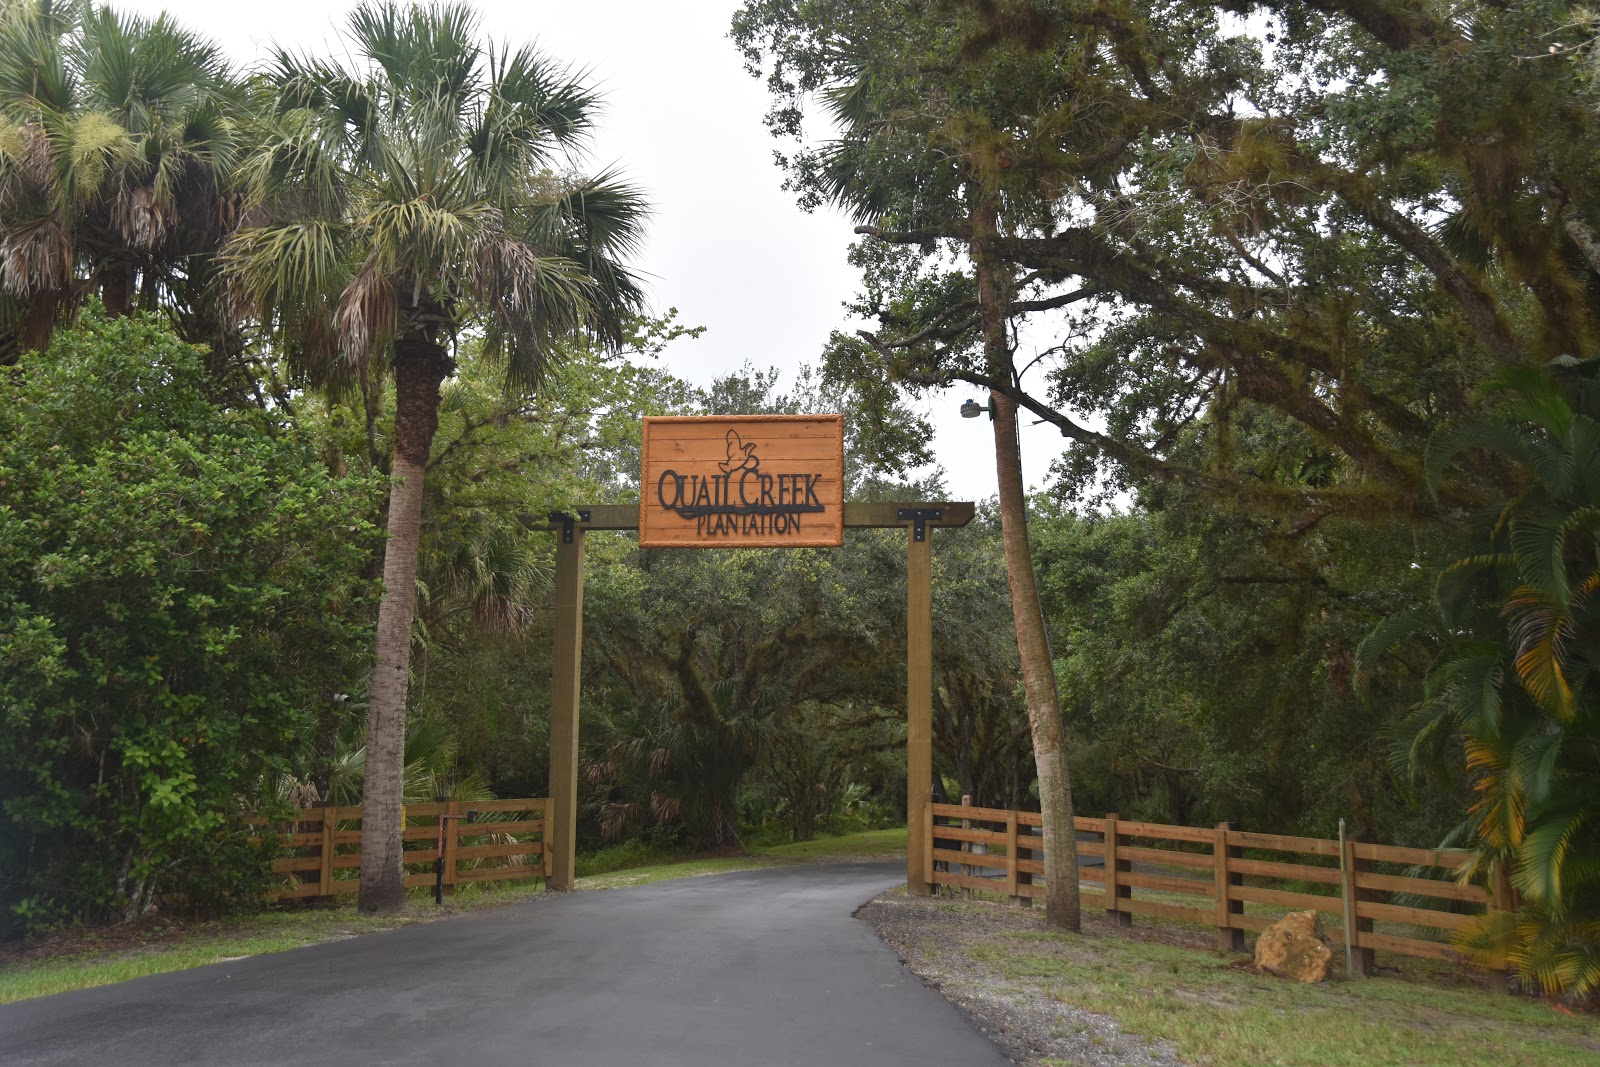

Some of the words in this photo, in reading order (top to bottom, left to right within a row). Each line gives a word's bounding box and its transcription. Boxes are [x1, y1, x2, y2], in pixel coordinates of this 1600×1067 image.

[658, 469, 736, 518] QUAIL
[739, 469, 824, 510] CREEK
[697, 512, 801, 535] PLANTATION
